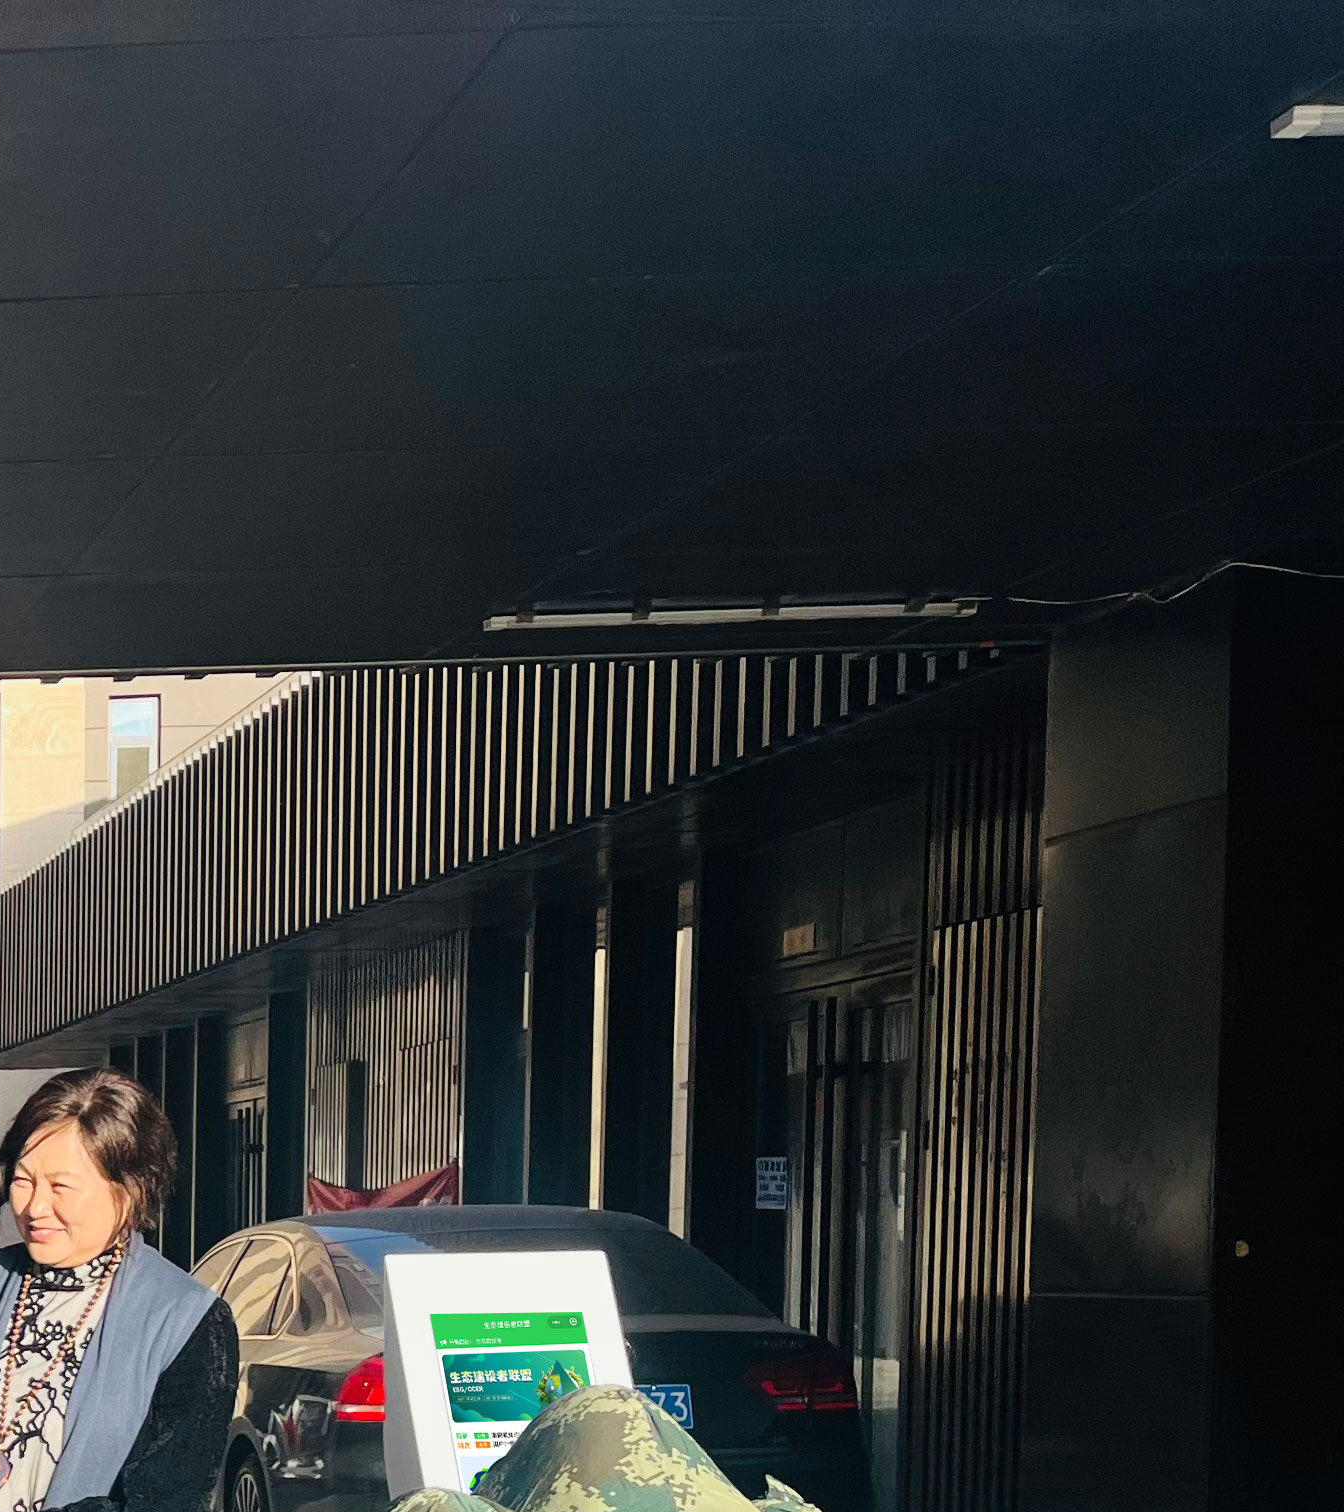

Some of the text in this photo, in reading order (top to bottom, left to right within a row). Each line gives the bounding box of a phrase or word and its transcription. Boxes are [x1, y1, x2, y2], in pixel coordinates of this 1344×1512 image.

[449, 1368, 533, 1384] 生态建设者联盟
